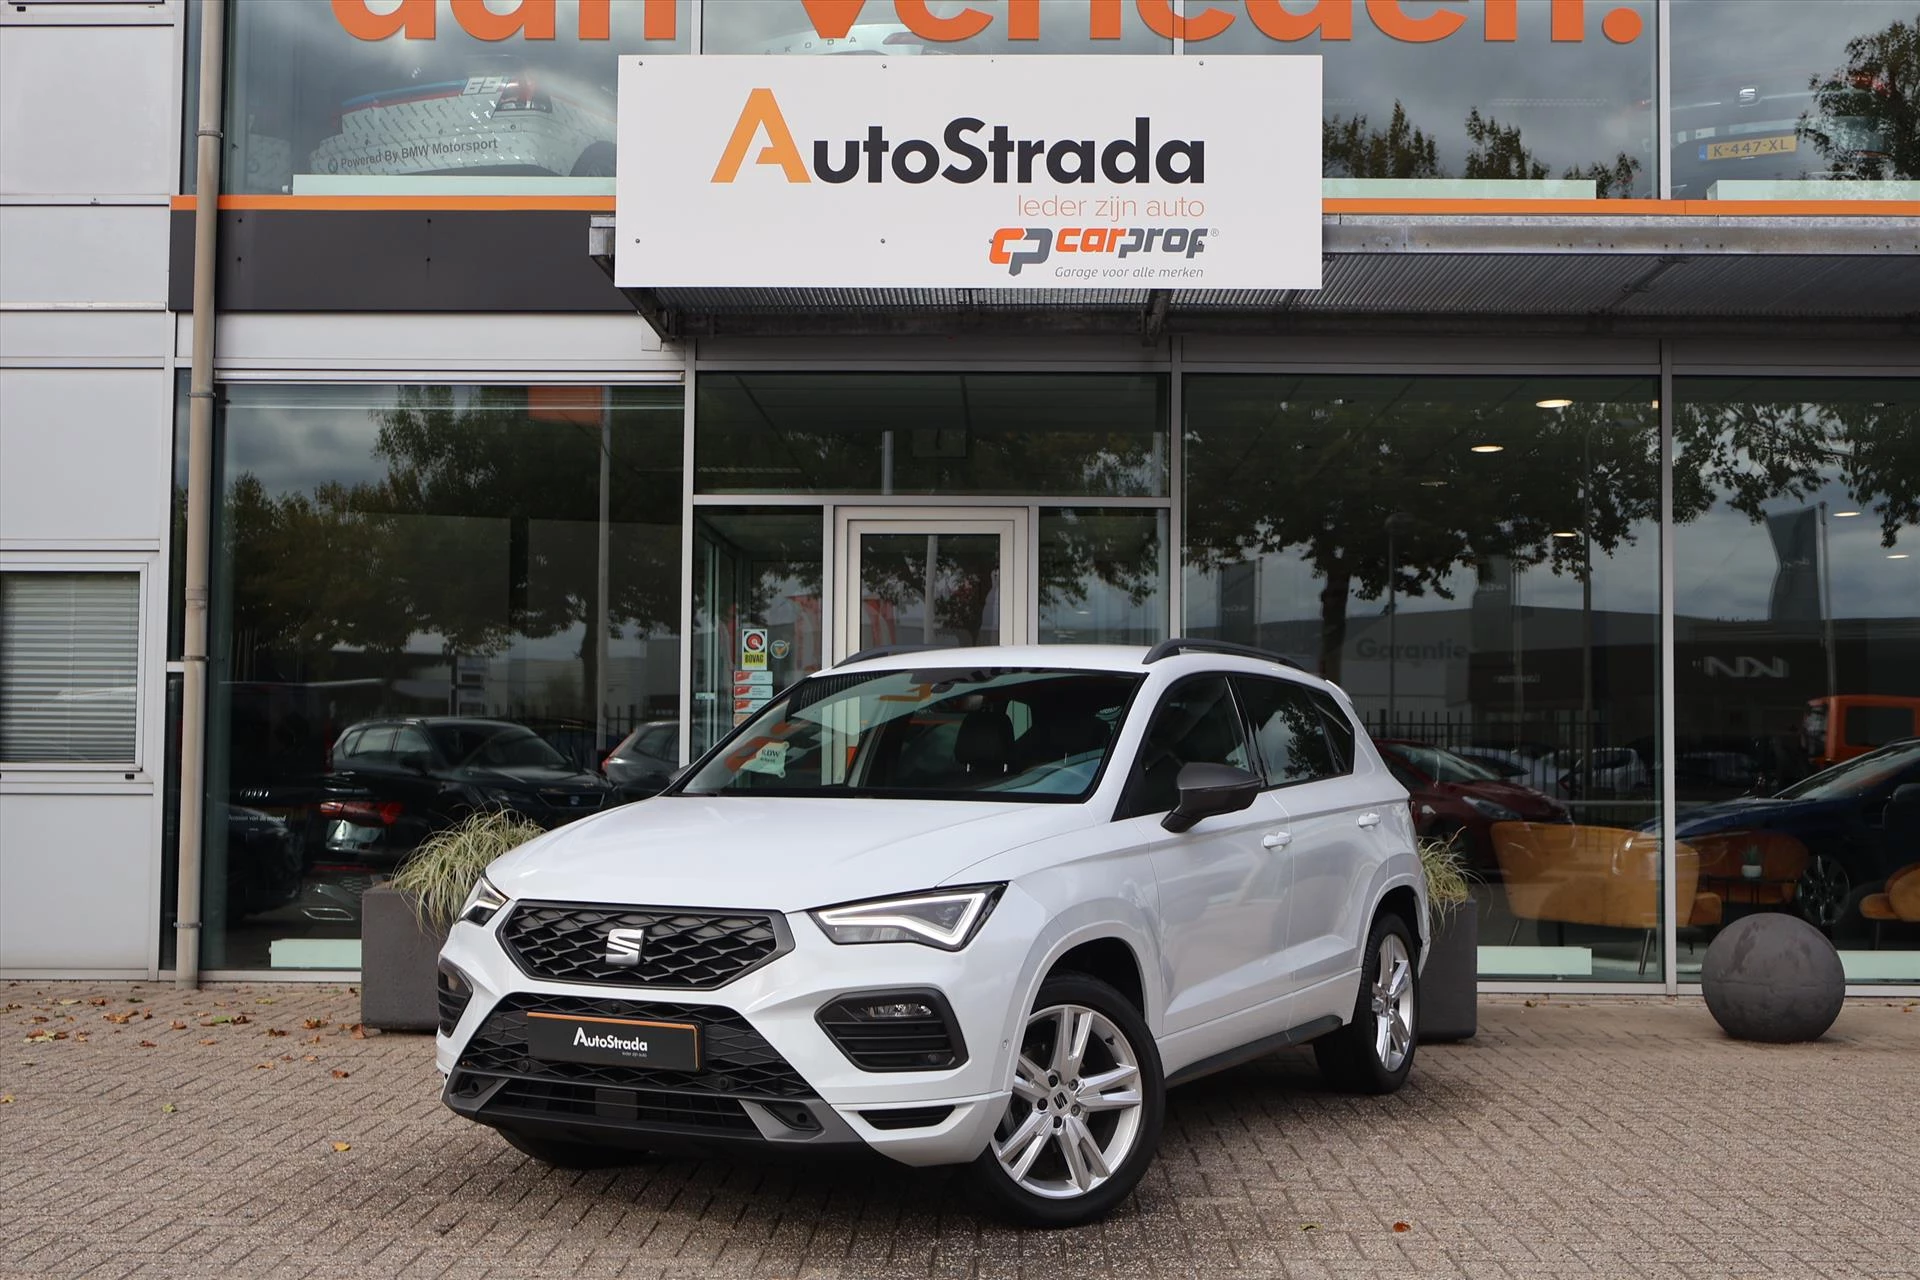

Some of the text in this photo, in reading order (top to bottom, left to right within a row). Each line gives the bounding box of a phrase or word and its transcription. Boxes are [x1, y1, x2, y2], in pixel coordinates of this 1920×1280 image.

[710, 88, 1205, 184] AutoStrada
[1713, 139, 1789, 157] K-447-XL
[341, 138, 498, 168] Powered By BMW Motorsport
[1018, 195, 1205, 222] Ieder zijn auto
[1055, 266, 1204, 280] Garage voor alle merken
[573, 1026, 648, 1052] AutoStrada
